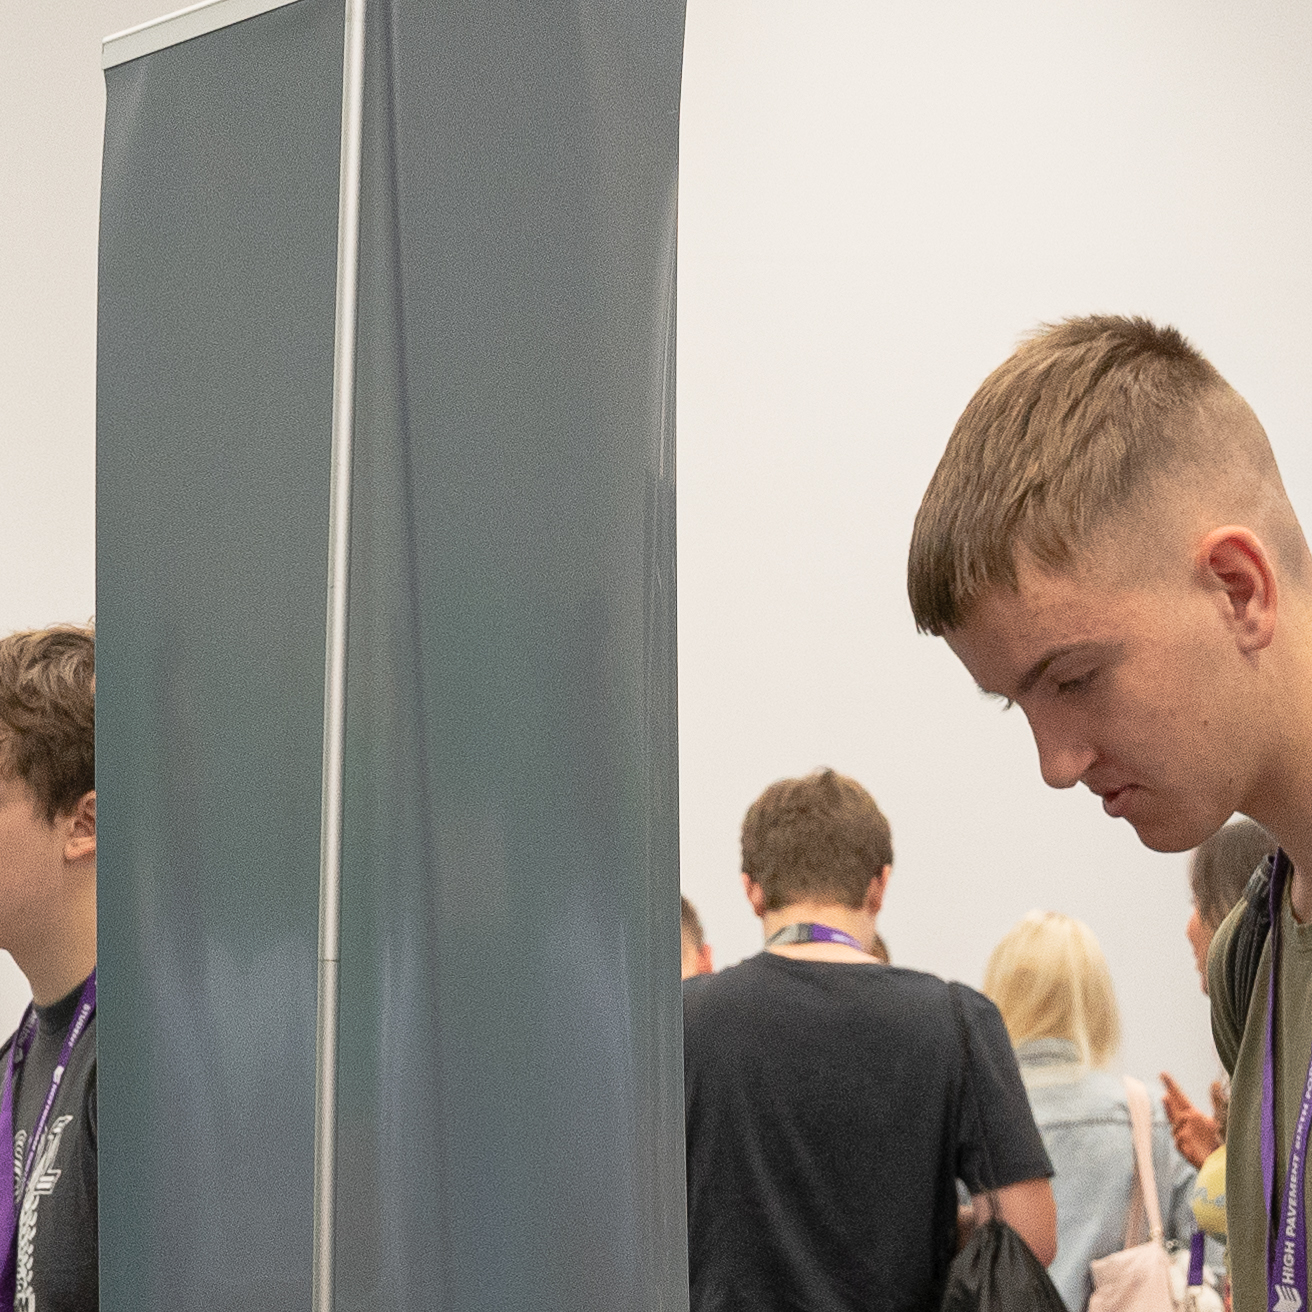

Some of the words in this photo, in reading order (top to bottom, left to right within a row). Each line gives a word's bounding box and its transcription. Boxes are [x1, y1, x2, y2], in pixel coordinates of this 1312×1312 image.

[1295, 1103, 1309, 1151] SIXTH
[1285, 1153, 1300, 1238] PAVEMENT
[1280, 1241, 1296, 1285] HIGH
